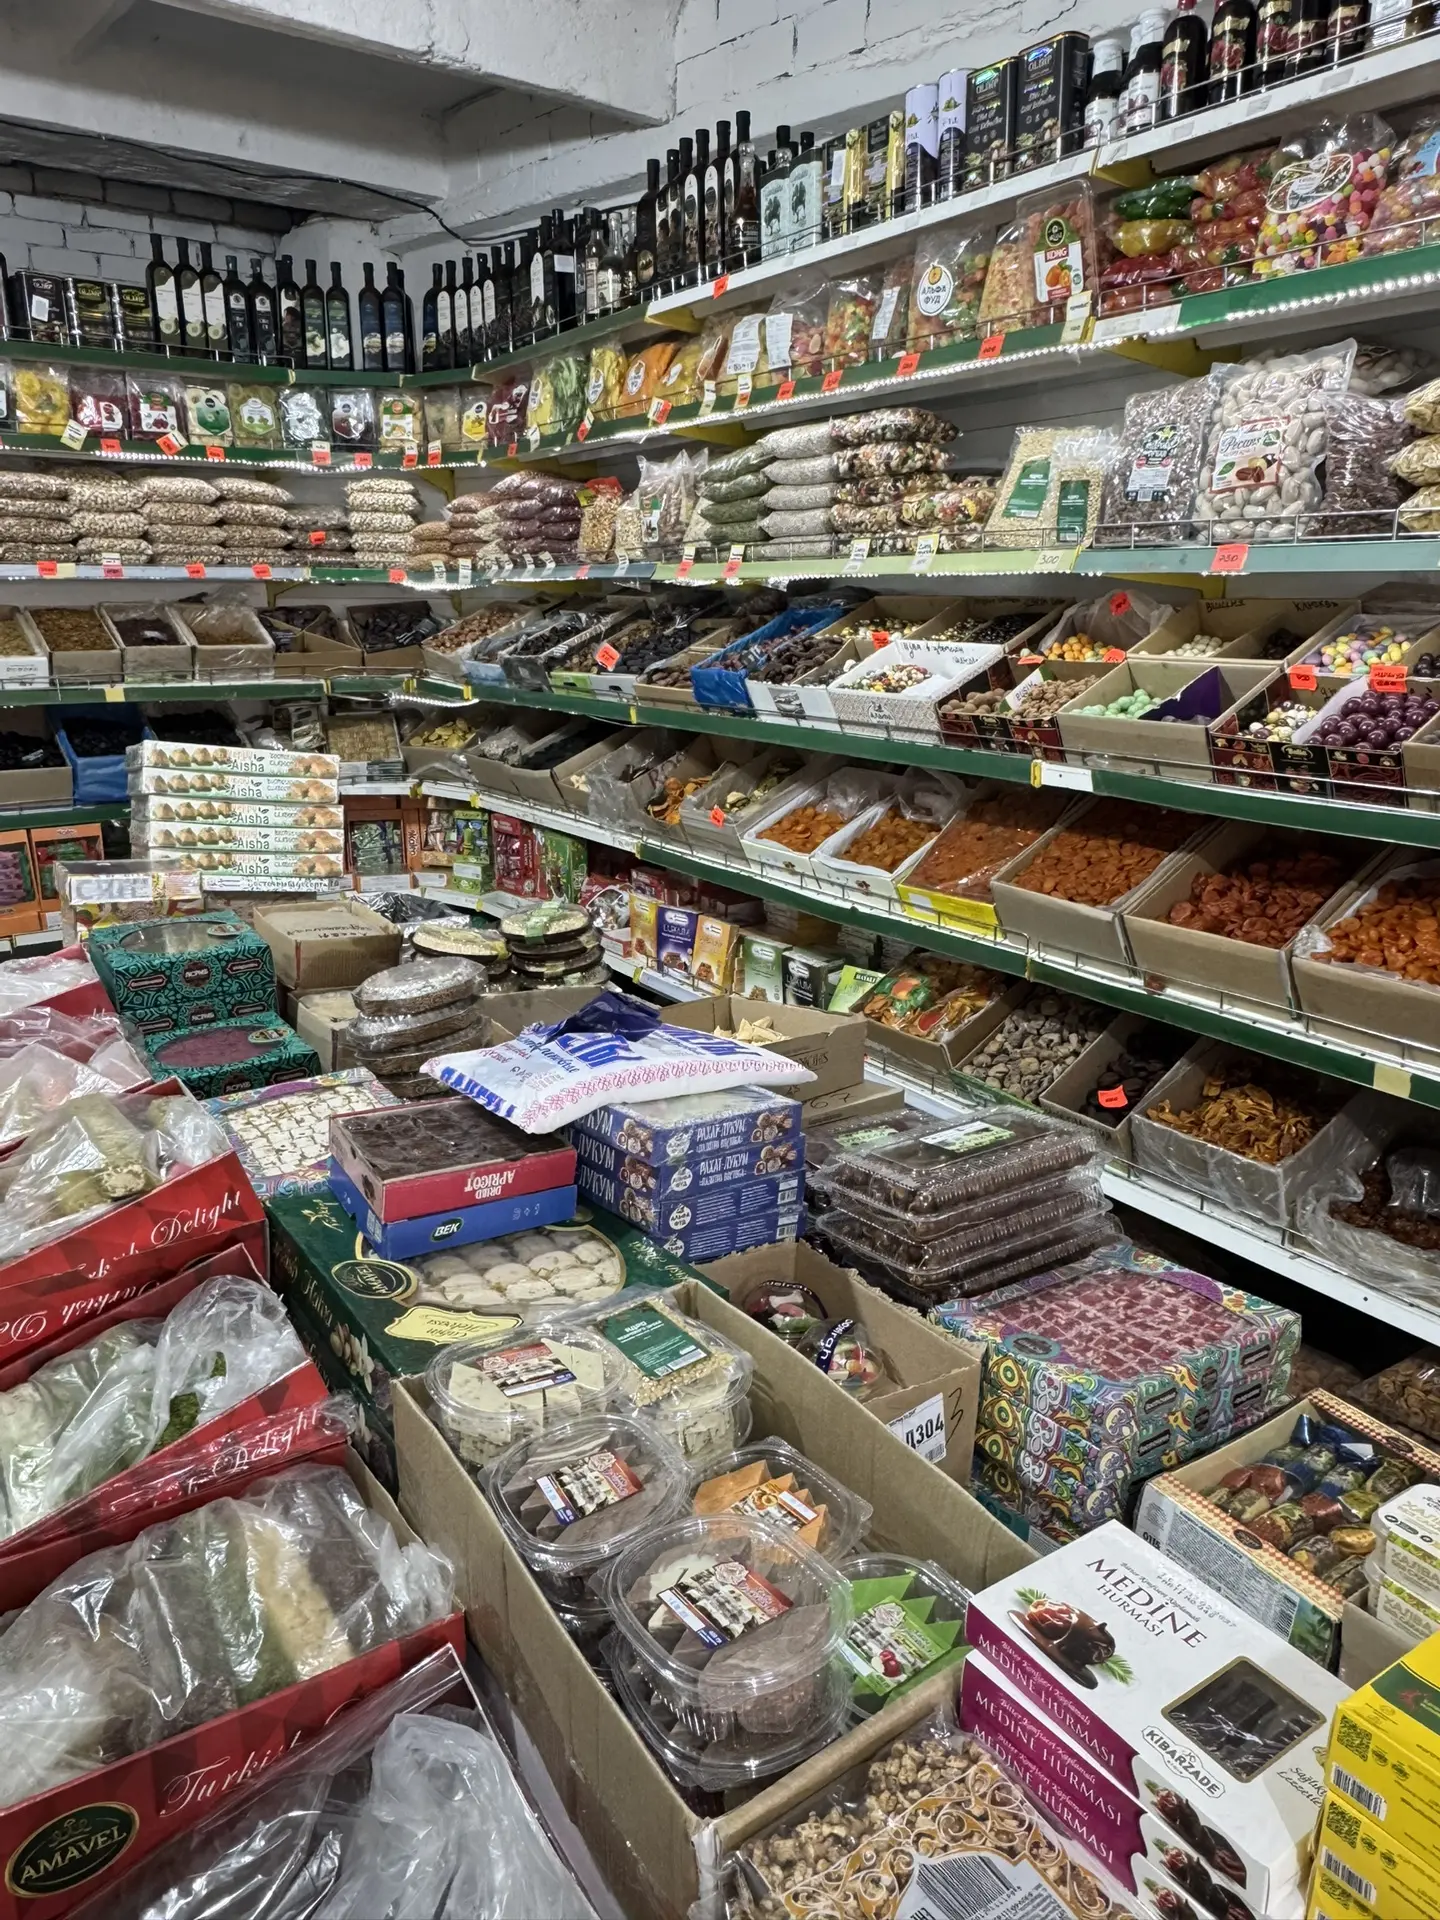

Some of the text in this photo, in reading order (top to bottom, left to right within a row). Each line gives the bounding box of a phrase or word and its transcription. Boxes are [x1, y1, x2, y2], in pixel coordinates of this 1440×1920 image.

[921, 285, 946, 297] АЛЬФА
[923, 295, 941, 305] ФУД
[230, 758, 265, 773] Aisha
[229, 784, 262, 797] Aisha
[236, 811, 270, 825] Aisha
[236, 836, 270, 850] Aisha
[236, 861, 270, 875] Aisha
[464, 1169, 516, 1192] APRICOT
[151, 1190, 241, 1248] Delight
[434, 1222, 460, 1237] BEK
[1085, 1558, 1208, 1648] MEDİNE
[1096, 1583, 1165, 1638] HURMASI
[1040, 1690, 1116, 1767] HURMASI
[1042, 1747, 1122, 1827] HURMASI
[1037, 1783, 1114, 1864] HURMASI
[19, 1825, 128, 1885] AMAVEL
